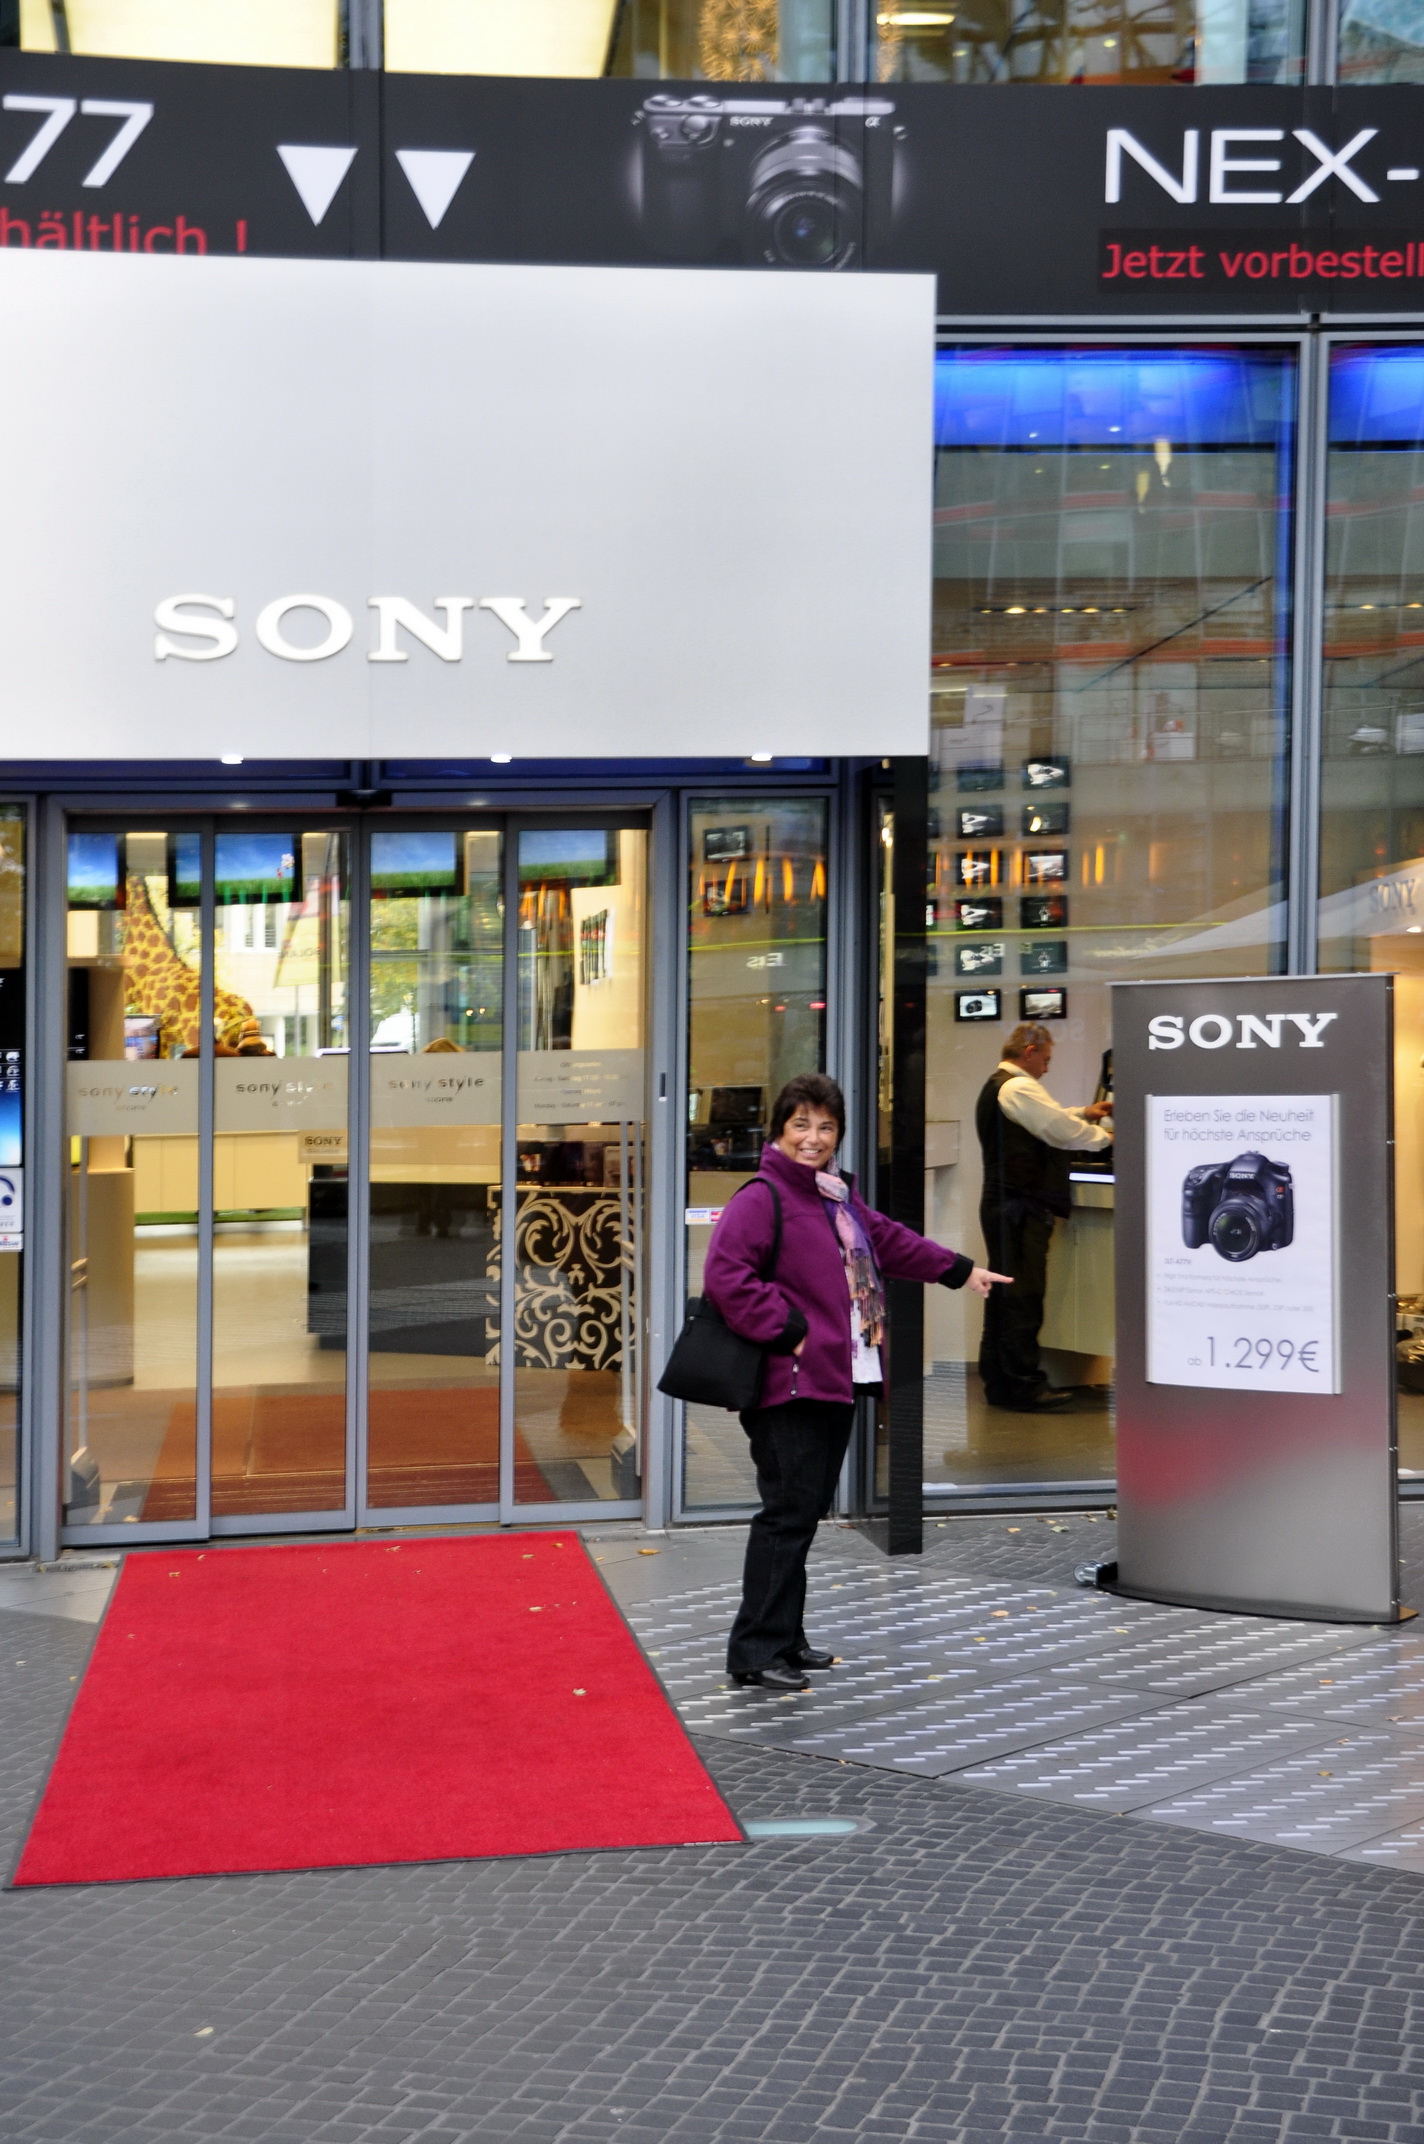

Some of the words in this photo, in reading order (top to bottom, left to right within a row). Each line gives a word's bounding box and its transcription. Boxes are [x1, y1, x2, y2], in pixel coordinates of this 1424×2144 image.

[729, 116, 774, 128] SONY
[2, 93, 155, 189] 77
[1104, 128, 1420, 204] NEX-
[1101, 244, 1205, 279] Jetzt
[152, 592, 582, 664] SONY
[1147, 1012, 1338, 1051] SONY
[78, 1086, 125, 1103] sony
[235, 1080, 283, 1100] sony
[437, 1076, 486, 1095] style
[1163, 1109, 1210, 1122] Erleben
[1213, 1109, 1232, 1122] Sie
[1235, 1109, 1257, 1122] die
[1259, 1109, 1315, 1122] Neuheit
[1163, 1128, 1179, 1141] für
[1182, 1128, 1233, 1141] höchste
[1236, 1128, 1312, 1144] Ansprüche
[1229, 1172, 1256, 1180] SONY
[1187, 1357, 1202, 1367] ab
[1206, 1336, 1320, 1373] 1.299€
